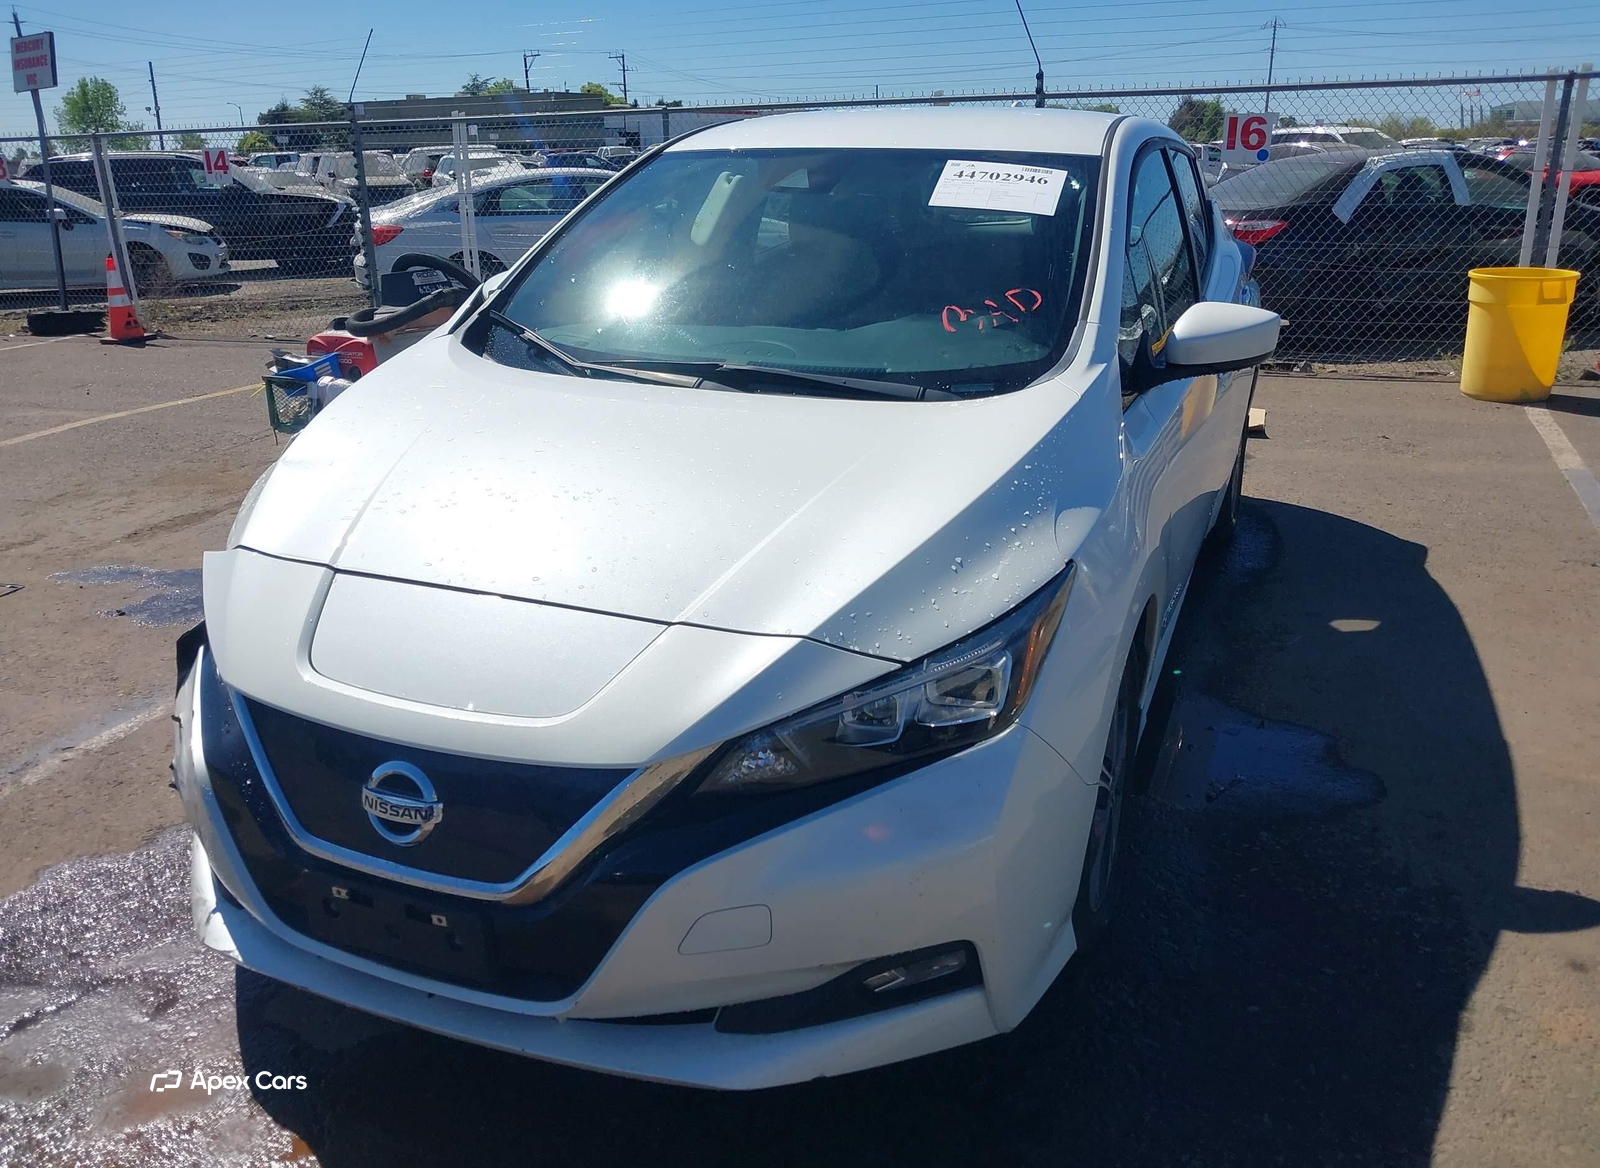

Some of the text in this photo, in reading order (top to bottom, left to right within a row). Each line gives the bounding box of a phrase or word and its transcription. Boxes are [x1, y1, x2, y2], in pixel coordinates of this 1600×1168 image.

[14, 54, 49, 71] INSURANCE
[1226, 116, 1268, 151] 16
[204, 150, 230, 175] 14
[952, 169, 1049, 186] 44702946
[364, 795, 428, 820] NISSAN
